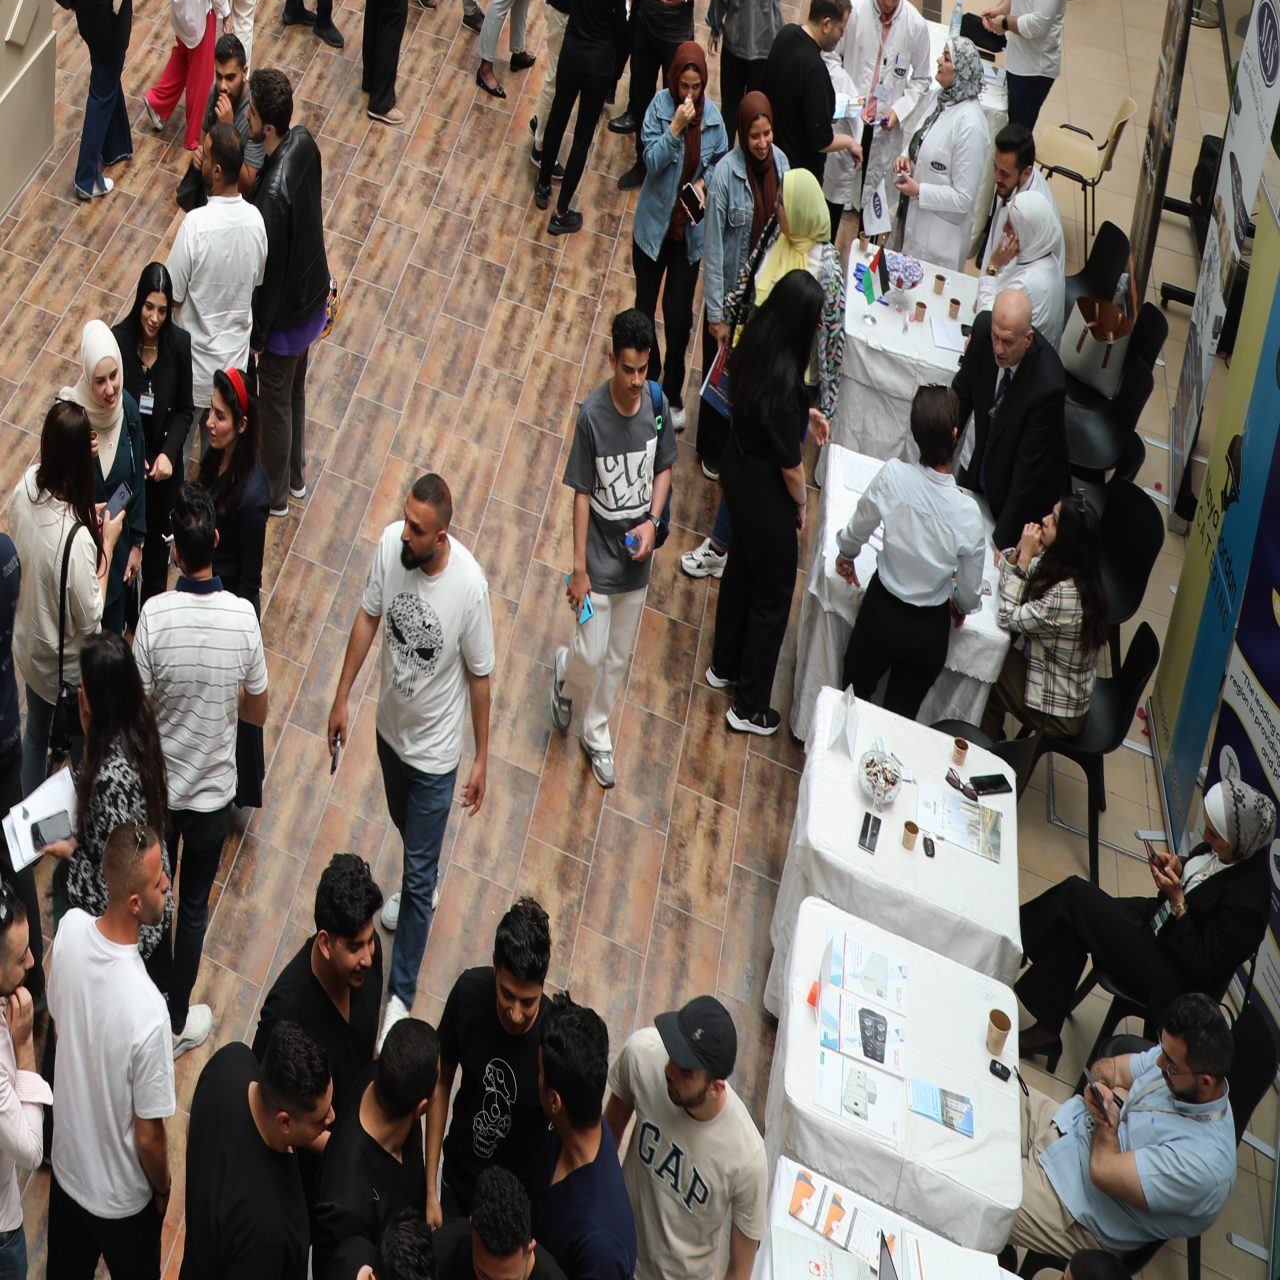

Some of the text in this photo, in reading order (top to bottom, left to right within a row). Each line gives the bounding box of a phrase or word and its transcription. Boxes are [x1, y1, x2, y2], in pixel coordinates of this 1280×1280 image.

[1230, 674, 1249, 707] region
[1254, 716, 1280, 768] providing
[1242, 670, 1276, 737] The leading
[1261, 747, 1273, 769] and
[639, 1121, 709, 1209] GAP
